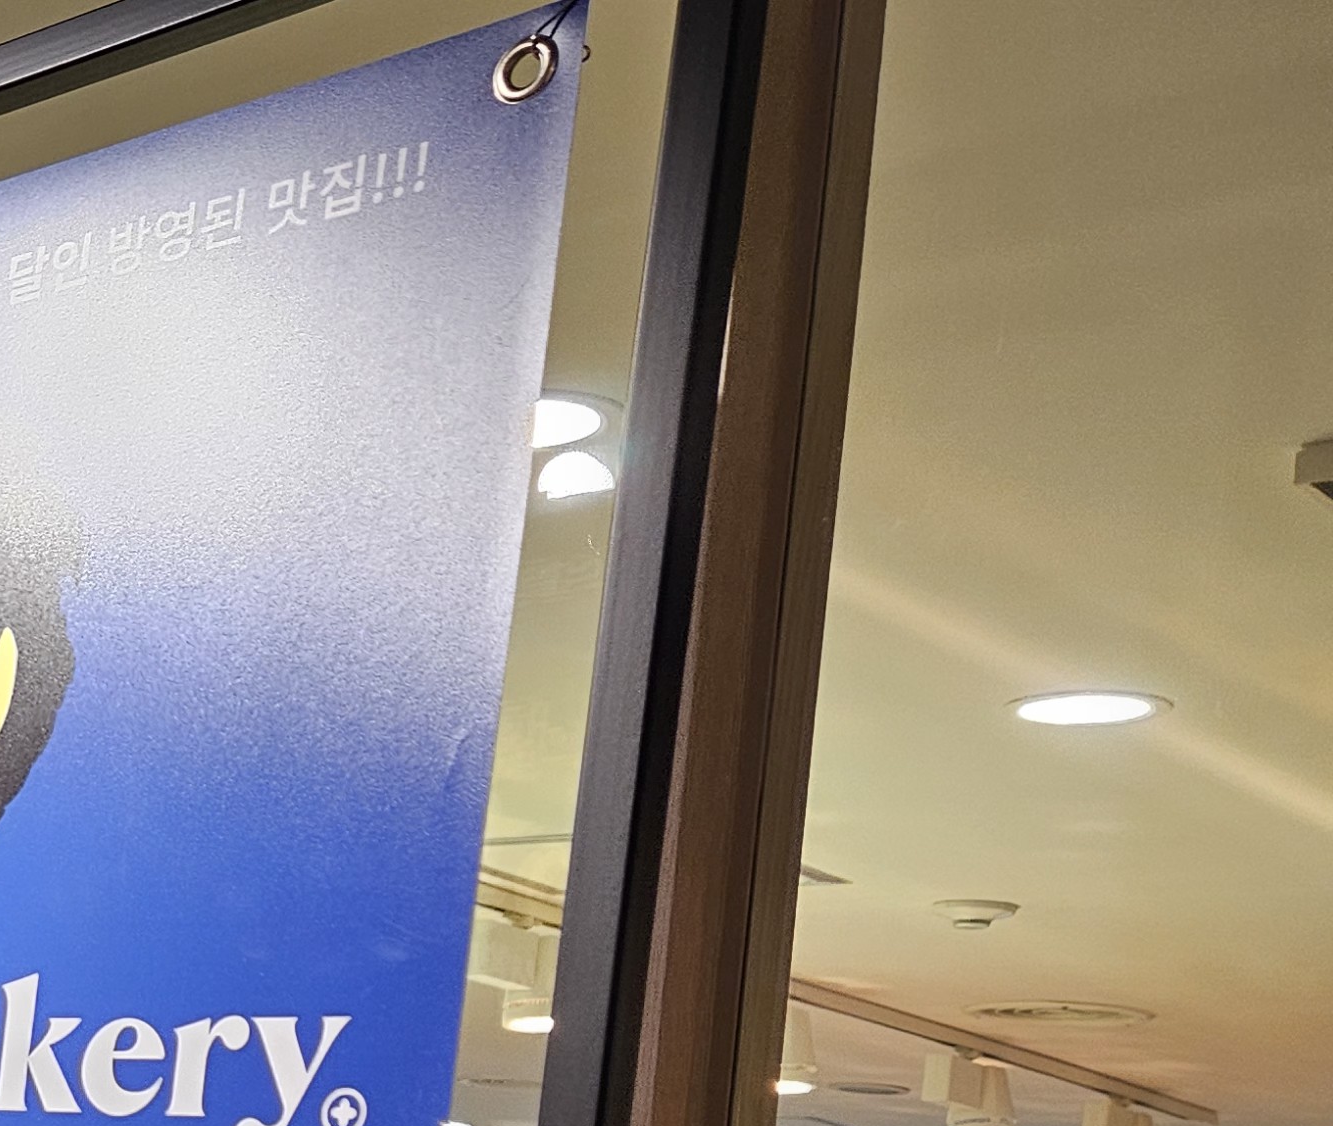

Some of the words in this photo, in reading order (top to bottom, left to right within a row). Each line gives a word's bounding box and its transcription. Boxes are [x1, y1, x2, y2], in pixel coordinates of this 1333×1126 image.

[6, 241, 90, 305] 달인
[109, 197, 245, 280] 방영된
[268, 140, 431, 237] 맛집!!!
